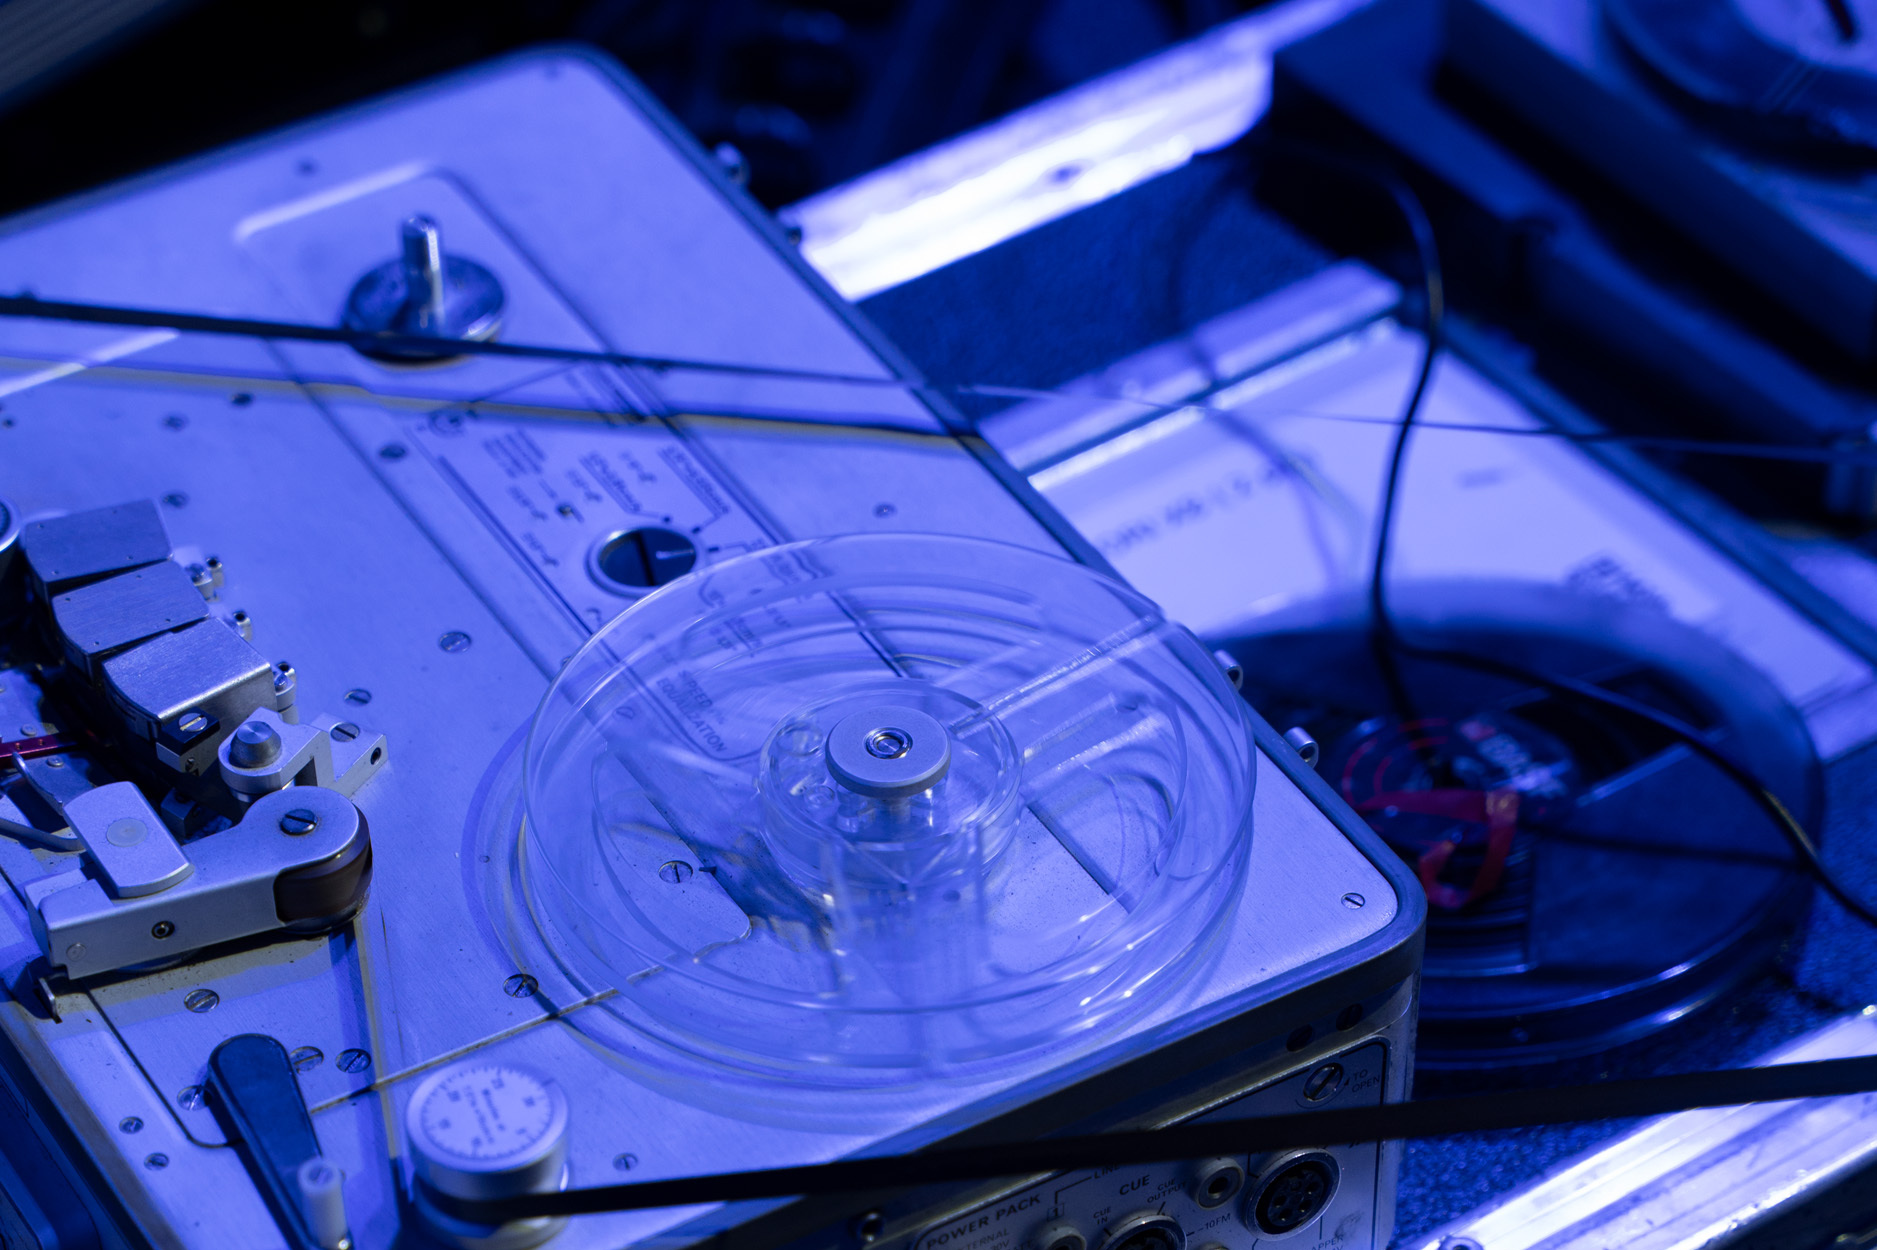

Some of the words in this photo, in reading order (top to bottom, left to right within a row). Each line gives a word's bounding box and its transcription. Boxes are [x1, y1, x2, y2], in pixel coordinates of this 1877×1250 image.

[657, 678, 728, 752] EQUALIZATION
[1351, 1074, 1380, 1093] OPEN
[1353, 1068, 1369, 1081] TO
[1119, 1174, 1151, 1196] CUE
[1146, 1180, 1187, 1203] OUTPUT
[1157, 1178, 1176, 1191] CUE
[995, 1192, 1042, 1221] PACK
[1092, 1206, 1112, 1219] CUE
[1096, 1216, 1108, 1225] IN
